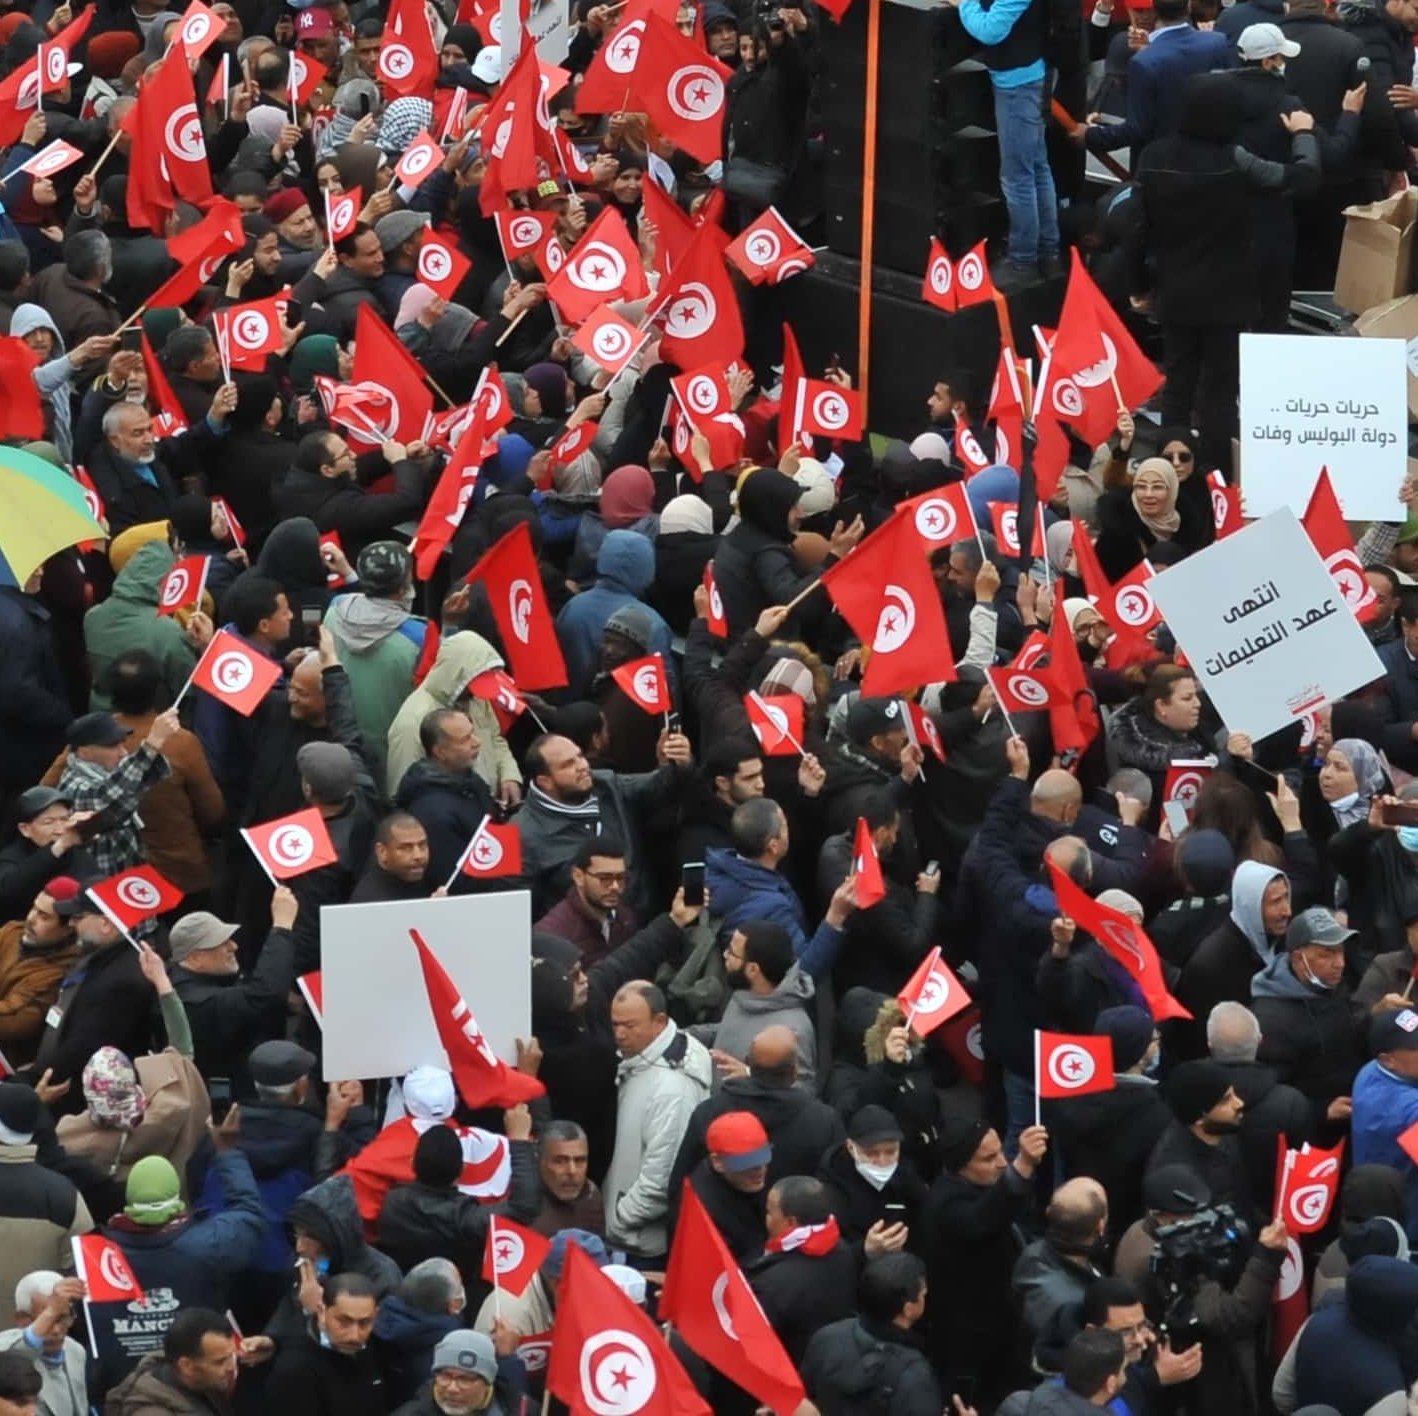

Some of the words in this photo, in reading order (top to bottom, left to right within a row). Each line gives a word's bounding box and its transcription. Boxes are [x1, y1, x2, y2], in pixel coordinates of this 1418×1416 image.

[1285, 398, 1329, 418] حريات
[1336, 399, 1380, 420] حريات
[1251, 424, 1291, 444] وفات
[1297, 425, 1356, 447] البوليس
[1361, 428, 1397, 448] دولة
[1221, 580, 1280, 626] انتهى
[1291, 598, 1338, 633] عهد
[1204, 620, 1289, 677] التعليمات
